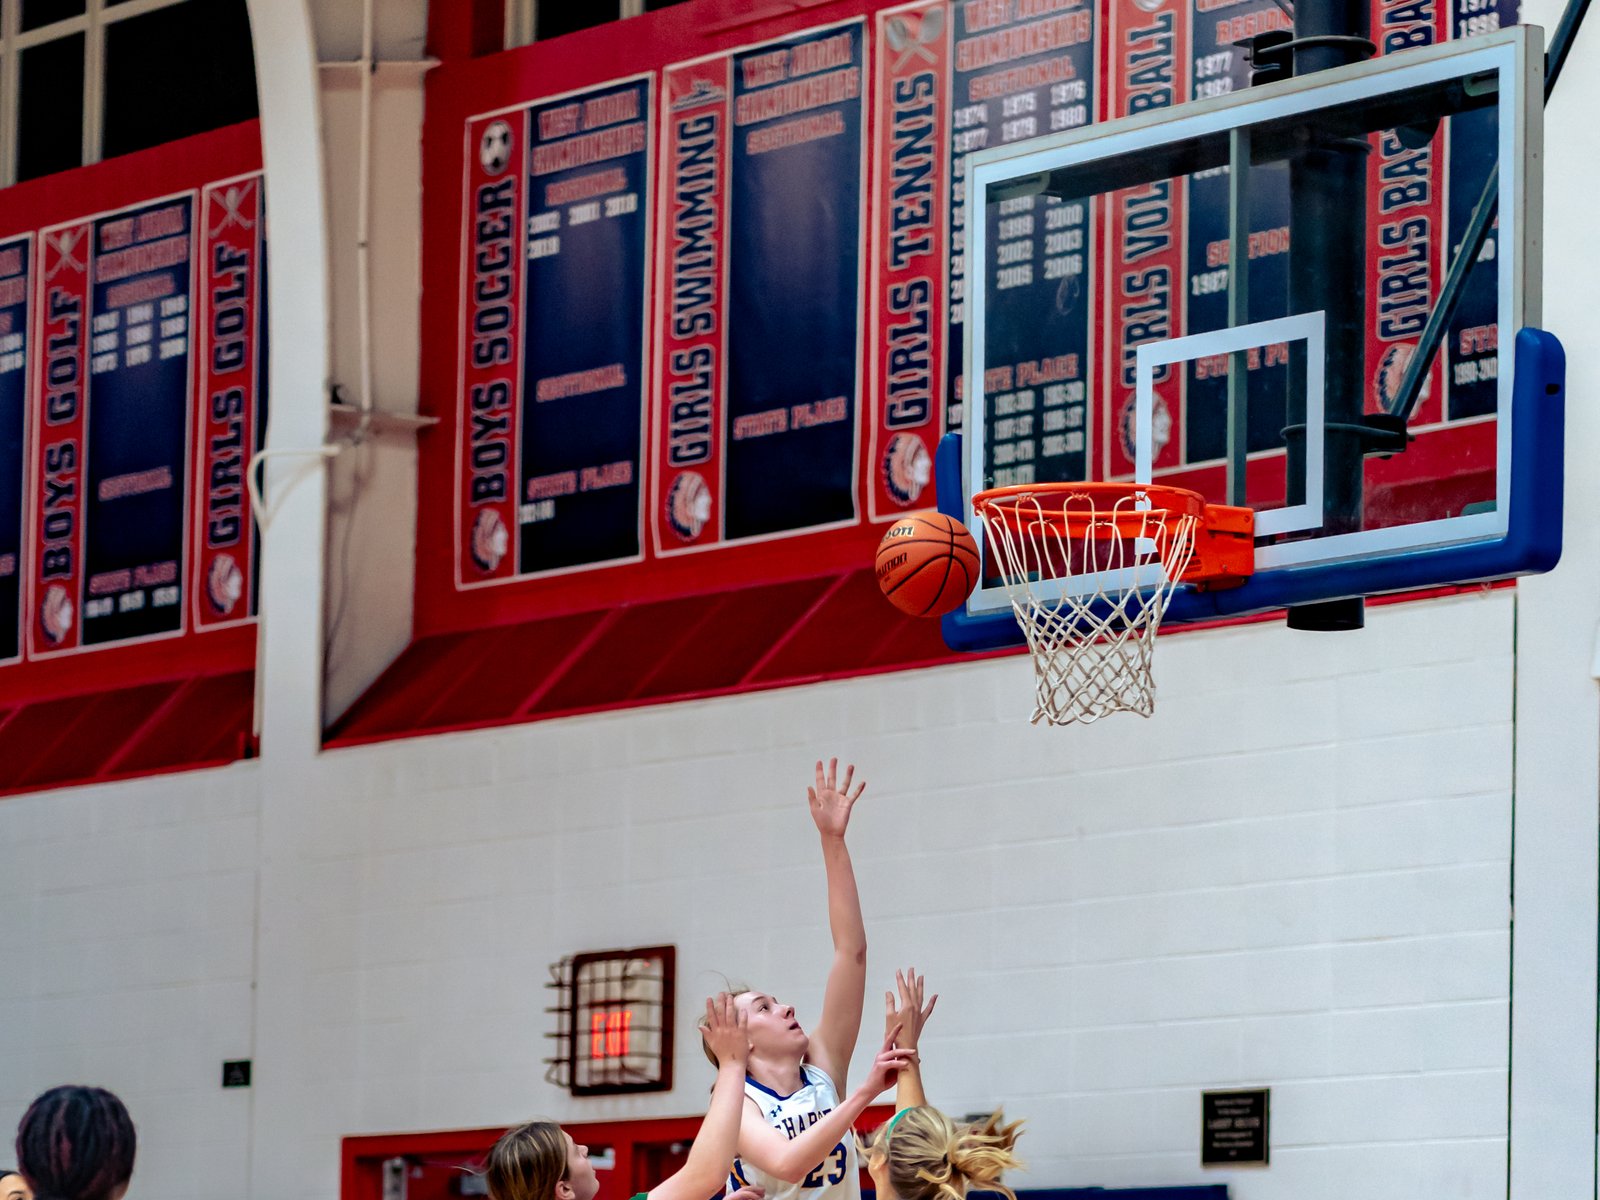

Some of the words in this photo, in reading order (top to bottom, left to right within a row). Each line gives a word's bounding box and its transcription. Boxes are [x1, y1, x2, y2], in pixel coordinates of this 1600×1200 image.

[968, 55, 1076, 101] SECTIONAL
[1196, 51, 1233, 78] 1977
[1216, 6, 1294, 45] REGION
[672, 112, 719, 340] SWIMMING
[888, 70, 938, 272] TENNIS
[1045, 204, 1083, 230] 2000
[211, 242, 249, 374] GOLF
[472, 174, 517, 369] SOCCER
[997, 239, 1033, 265] 2002
[1191, 269, 1229, 296] 1987
[1376, 215, 1430, 341] GIRLS
[47, 286, 81, 425] GOLF
[884, 276, 933, 430] GIRLS
[1016, 353, 1079, 388] PLACE
[1460, 323, 1498, 355] STA
[207, 386, 245, 549] GIRLS
[470, 378, 511, 507] BOYS
[668, 343, 715, 467] GIRLS
[733, 407, 789, 440] STATE
[791, 396, 848, 430] PLACE
[41, 438, 77, 581] BOYS
